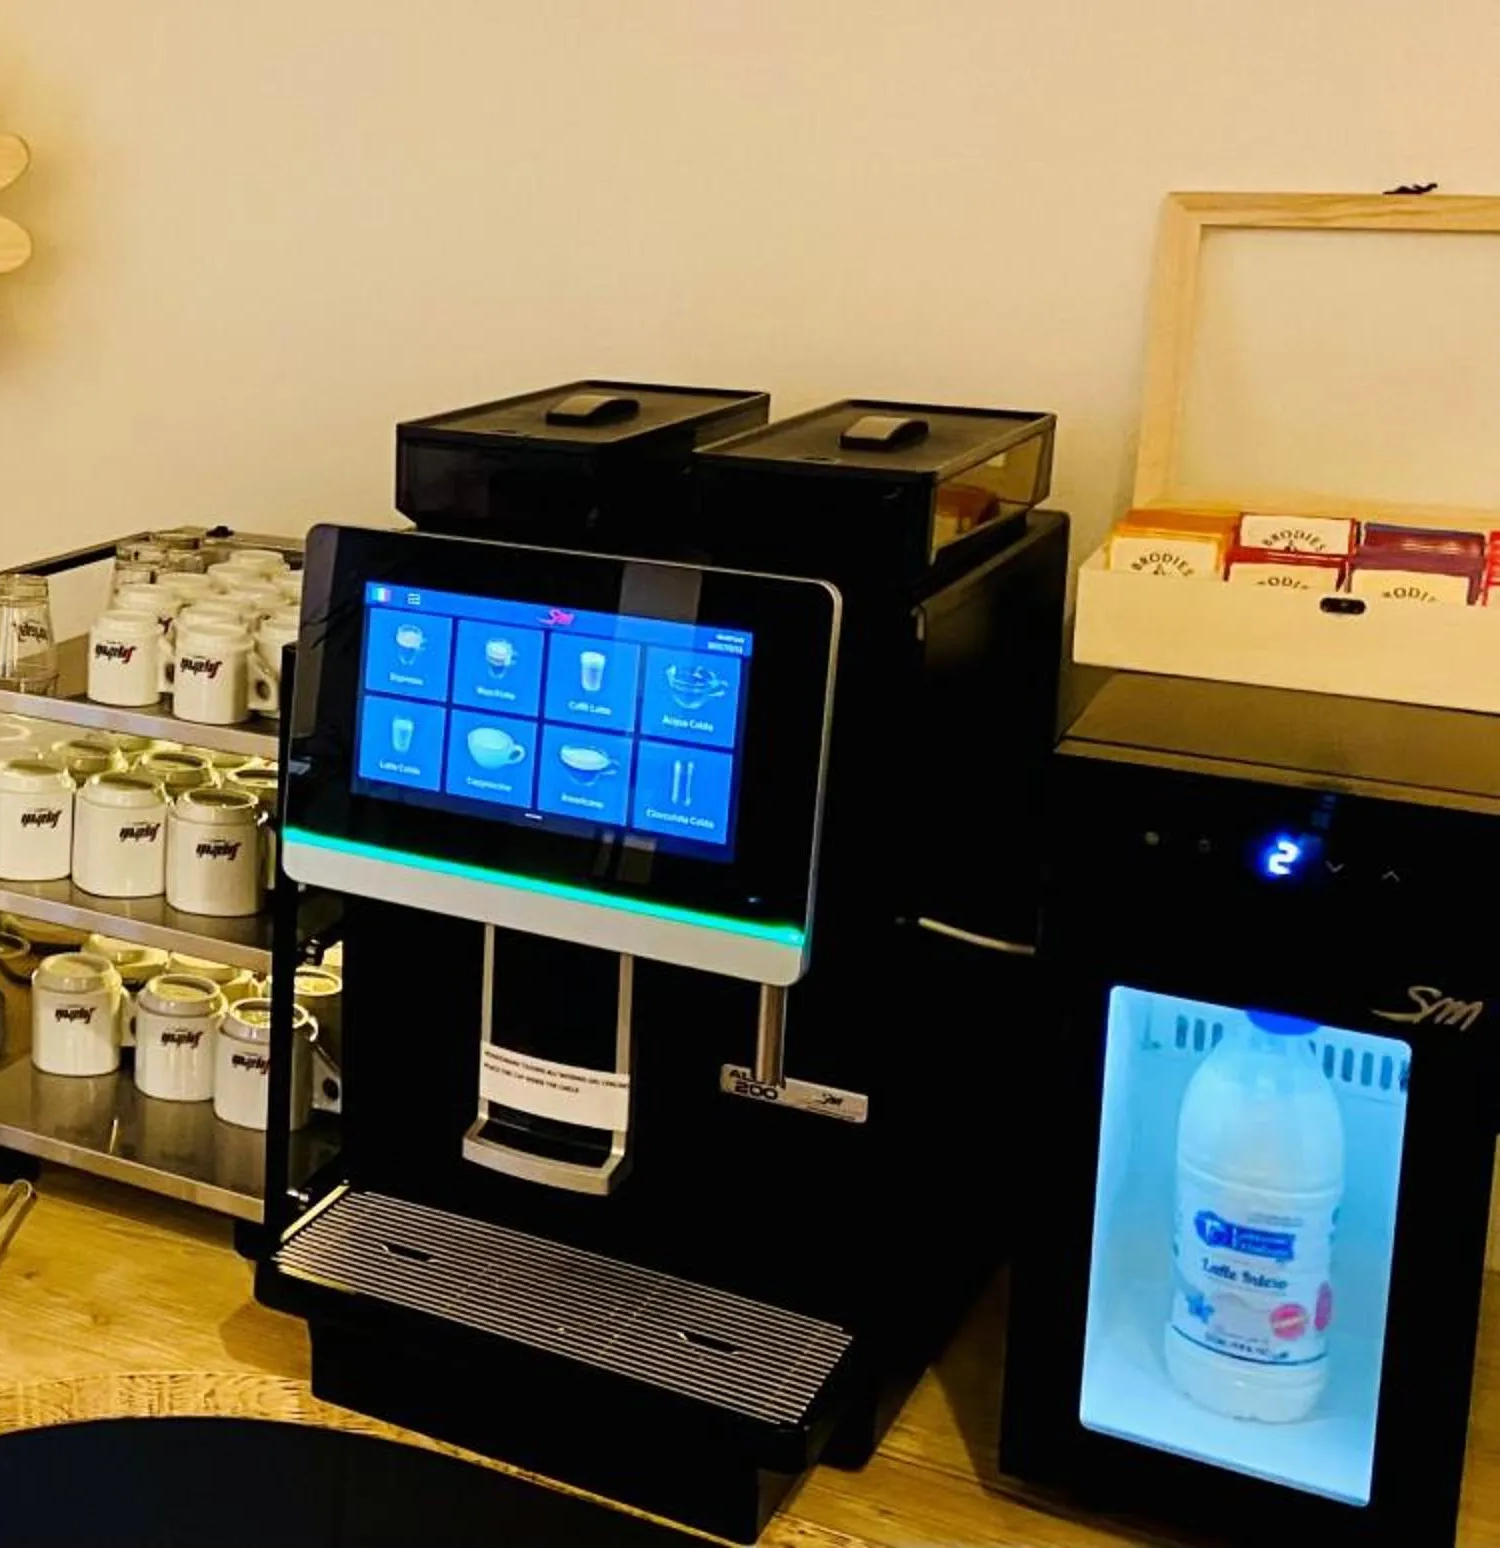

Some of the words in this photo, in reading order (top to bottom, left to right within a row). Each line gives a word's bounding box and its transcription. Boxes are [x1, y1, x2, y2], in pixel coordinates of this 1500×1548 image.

[1258, 530, 1326, 552] BRODIES
[1131, 553, 1194, 576] BRODIES
[1267, 839, 1300, 876] 2
[734, 1080, 779, 1101] 200
